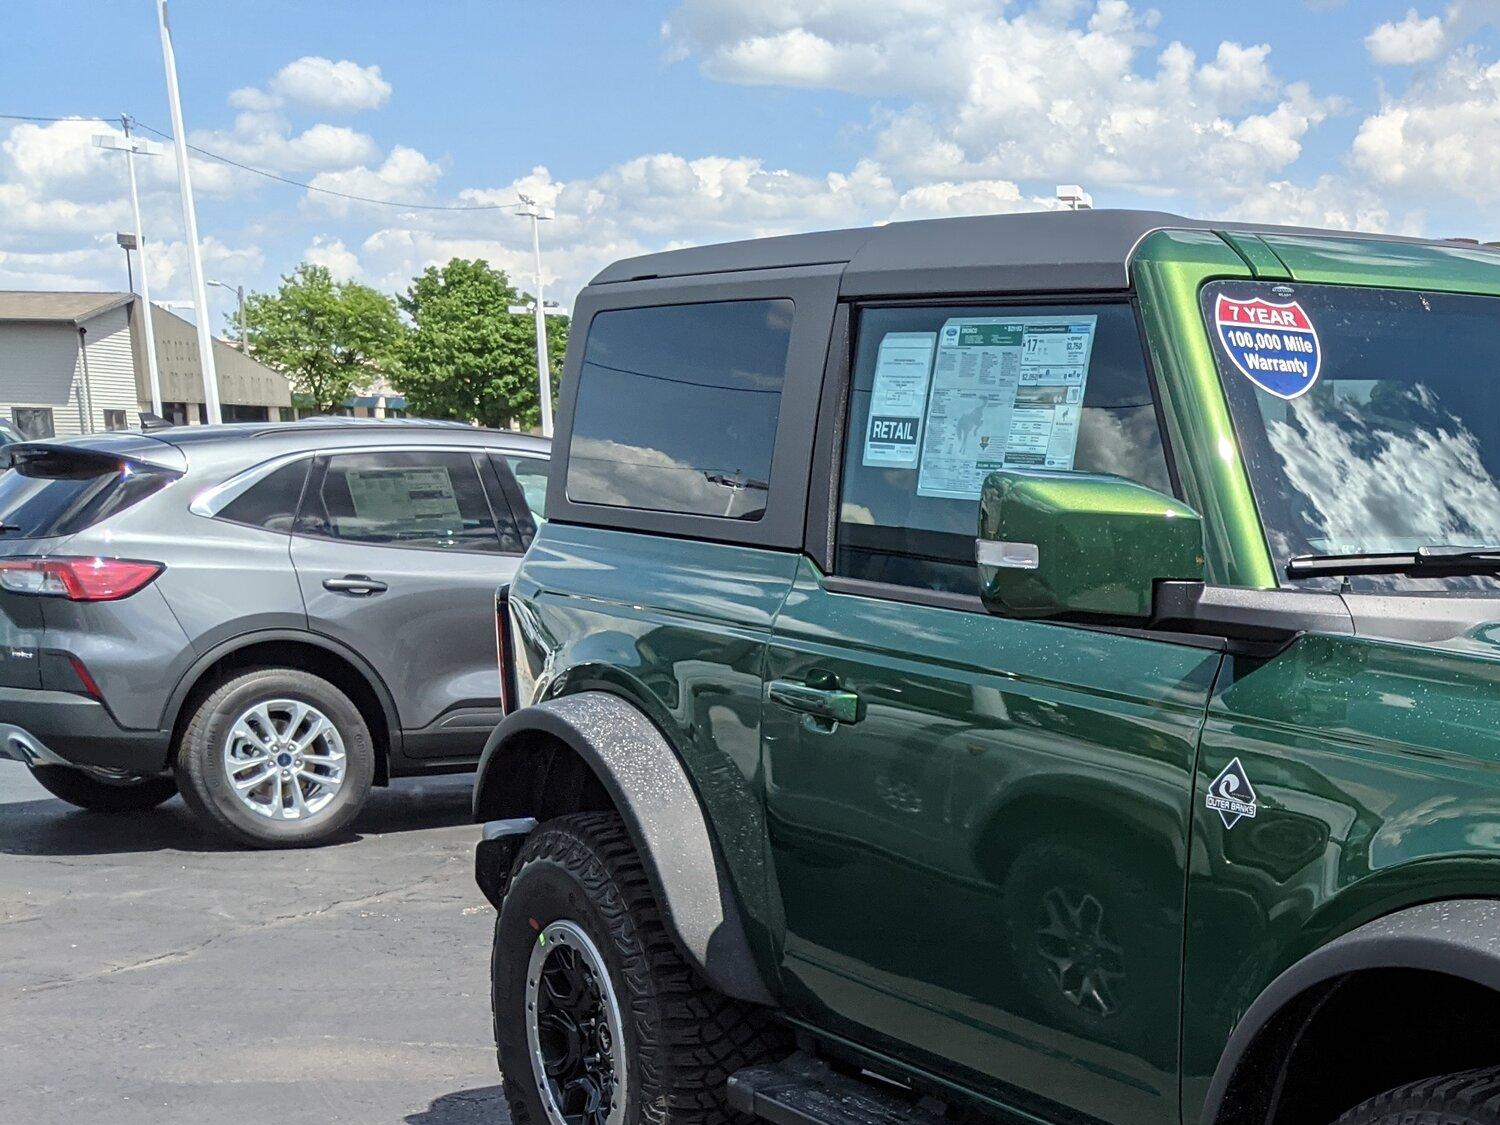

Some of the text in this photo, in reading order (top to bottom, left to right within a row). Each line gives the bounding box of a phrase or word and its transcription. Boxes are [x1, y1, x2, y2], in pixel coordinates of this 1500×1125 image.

[1229, 305, 1298, 326] 7 YEAR
[1228, 331, 1313, 354] 100,000 Mile
[1244, 353, 1308, 378] Warranty
[873, 420, 914, 441] RETAIL
[1208, 798, 1254, 815] OUTER BANKS
